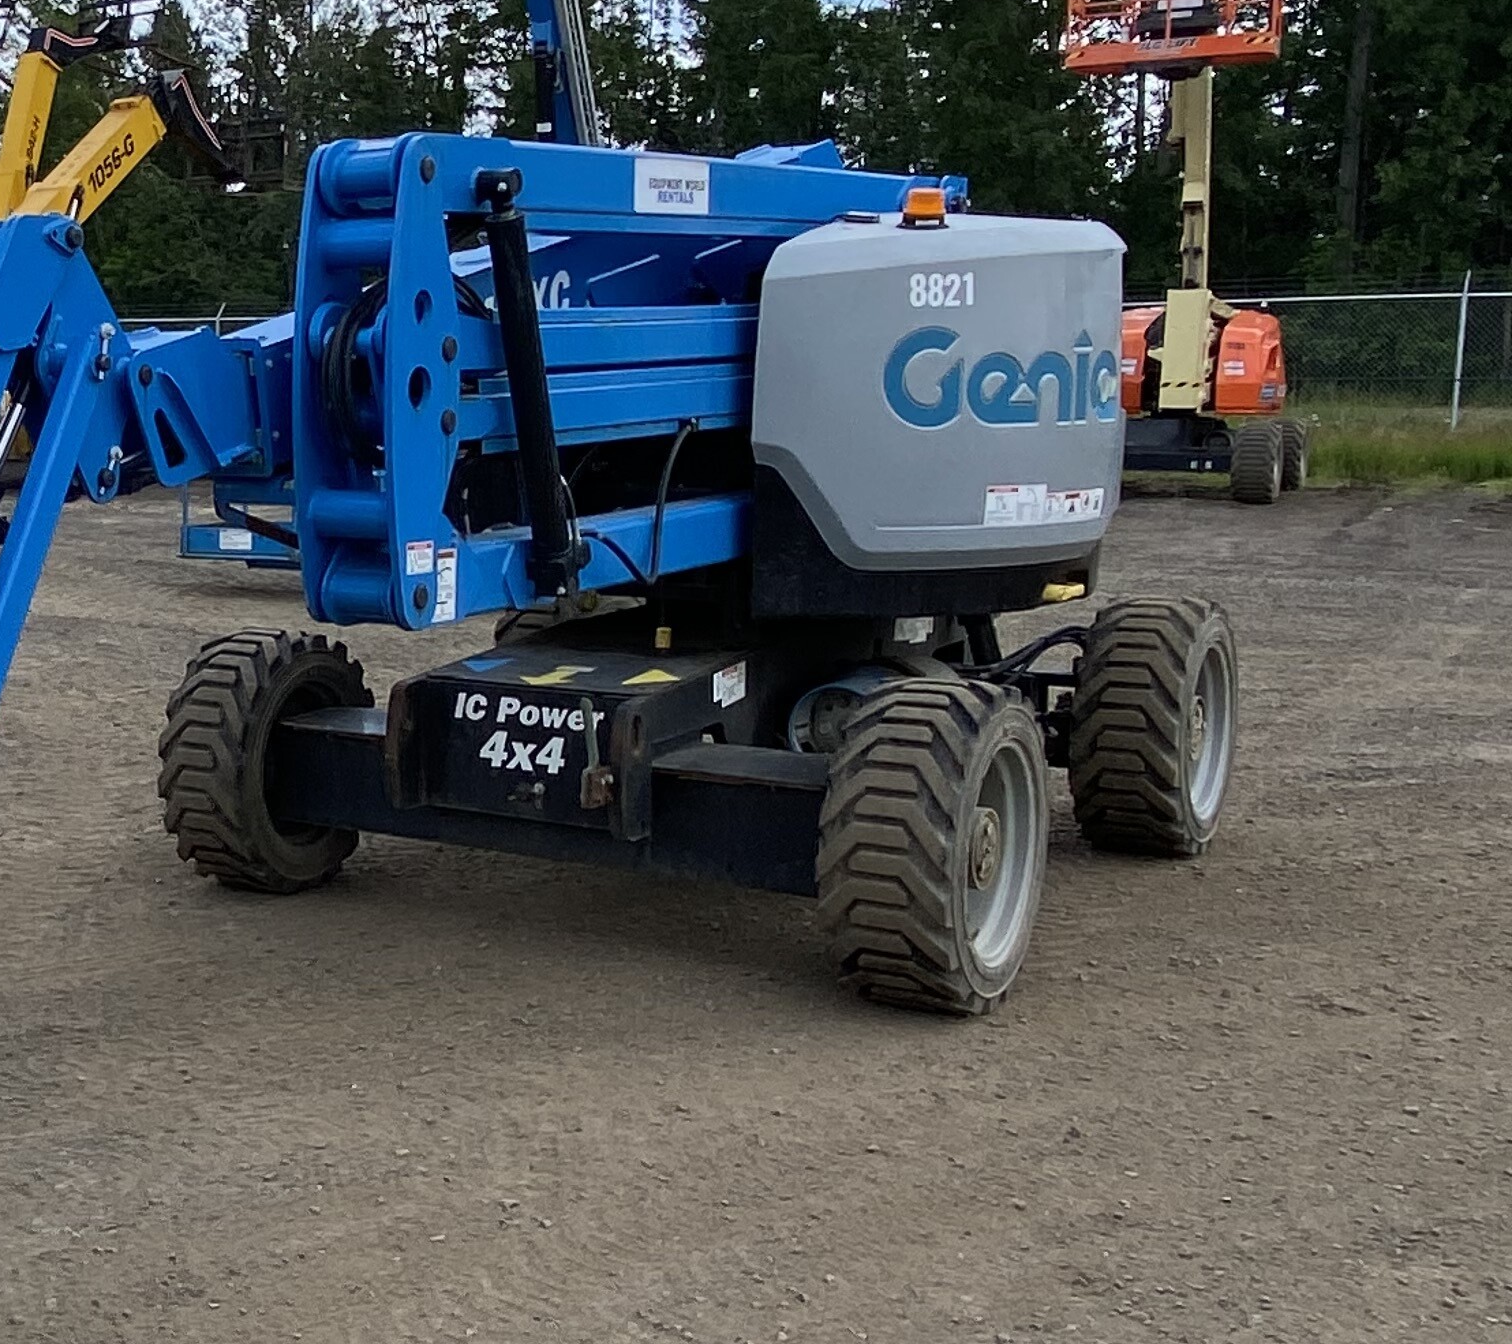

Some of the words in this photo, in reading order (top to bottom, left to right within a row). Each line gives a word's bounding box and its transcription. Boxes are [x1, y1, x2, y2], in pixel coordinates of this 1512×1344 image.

[88, 133, 135, 193] 1056-G
[657, 191, 694, 204] RENTALS
[909, 272, 974, 307] 8821
[454, 692, 488, 721] IC
[496, 696, 605, 731] Power
[479, 730, 566, 774] 4x4
